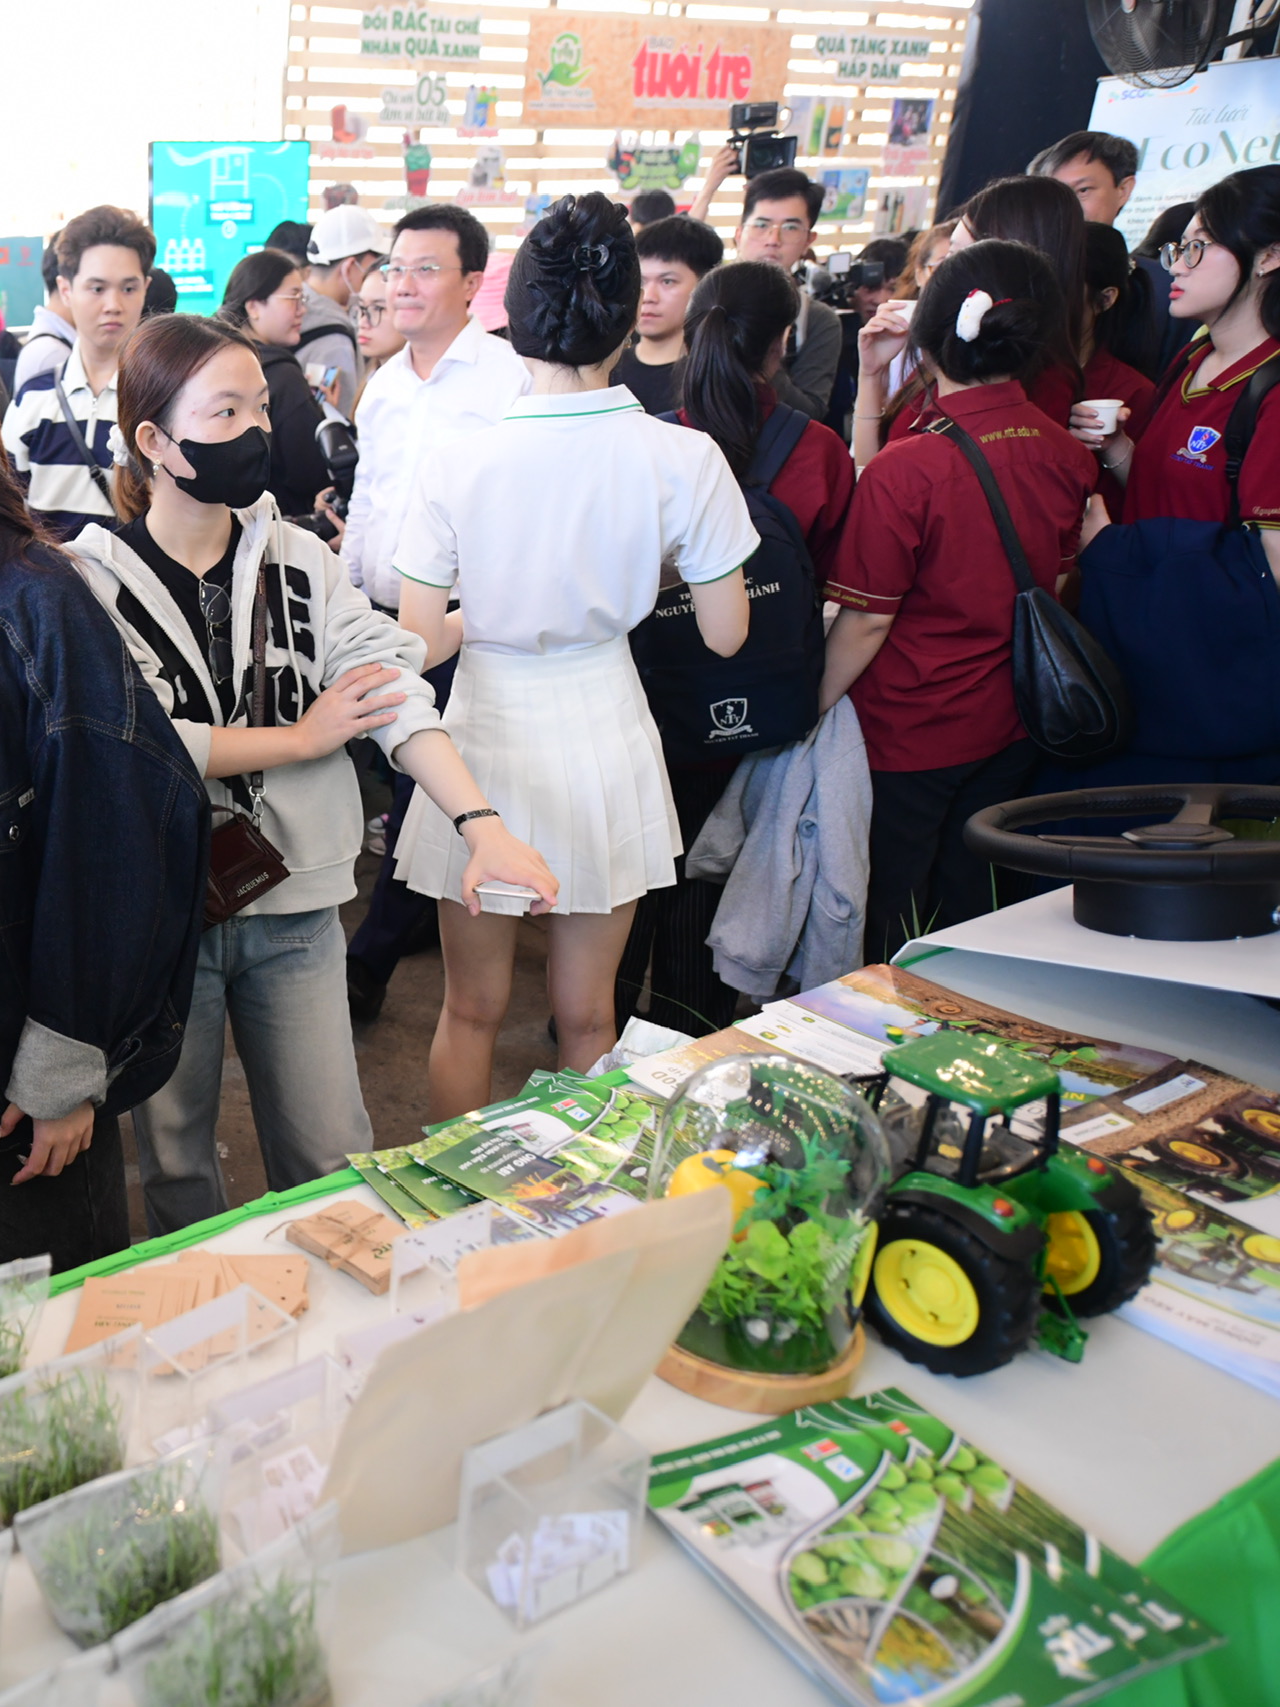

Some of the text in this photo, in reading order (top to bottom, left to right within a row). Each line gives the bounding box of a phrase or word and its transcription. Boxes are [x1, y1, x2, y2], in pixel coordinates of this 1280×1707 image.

[443, 43, 480, 58] XANH
[890, 40, 930, 57] XANH
[417, 76, 446, 106] 05
[746, 582, 781, 599] HÀNH
[236, 871, 269, 897] JACQUEMUS
